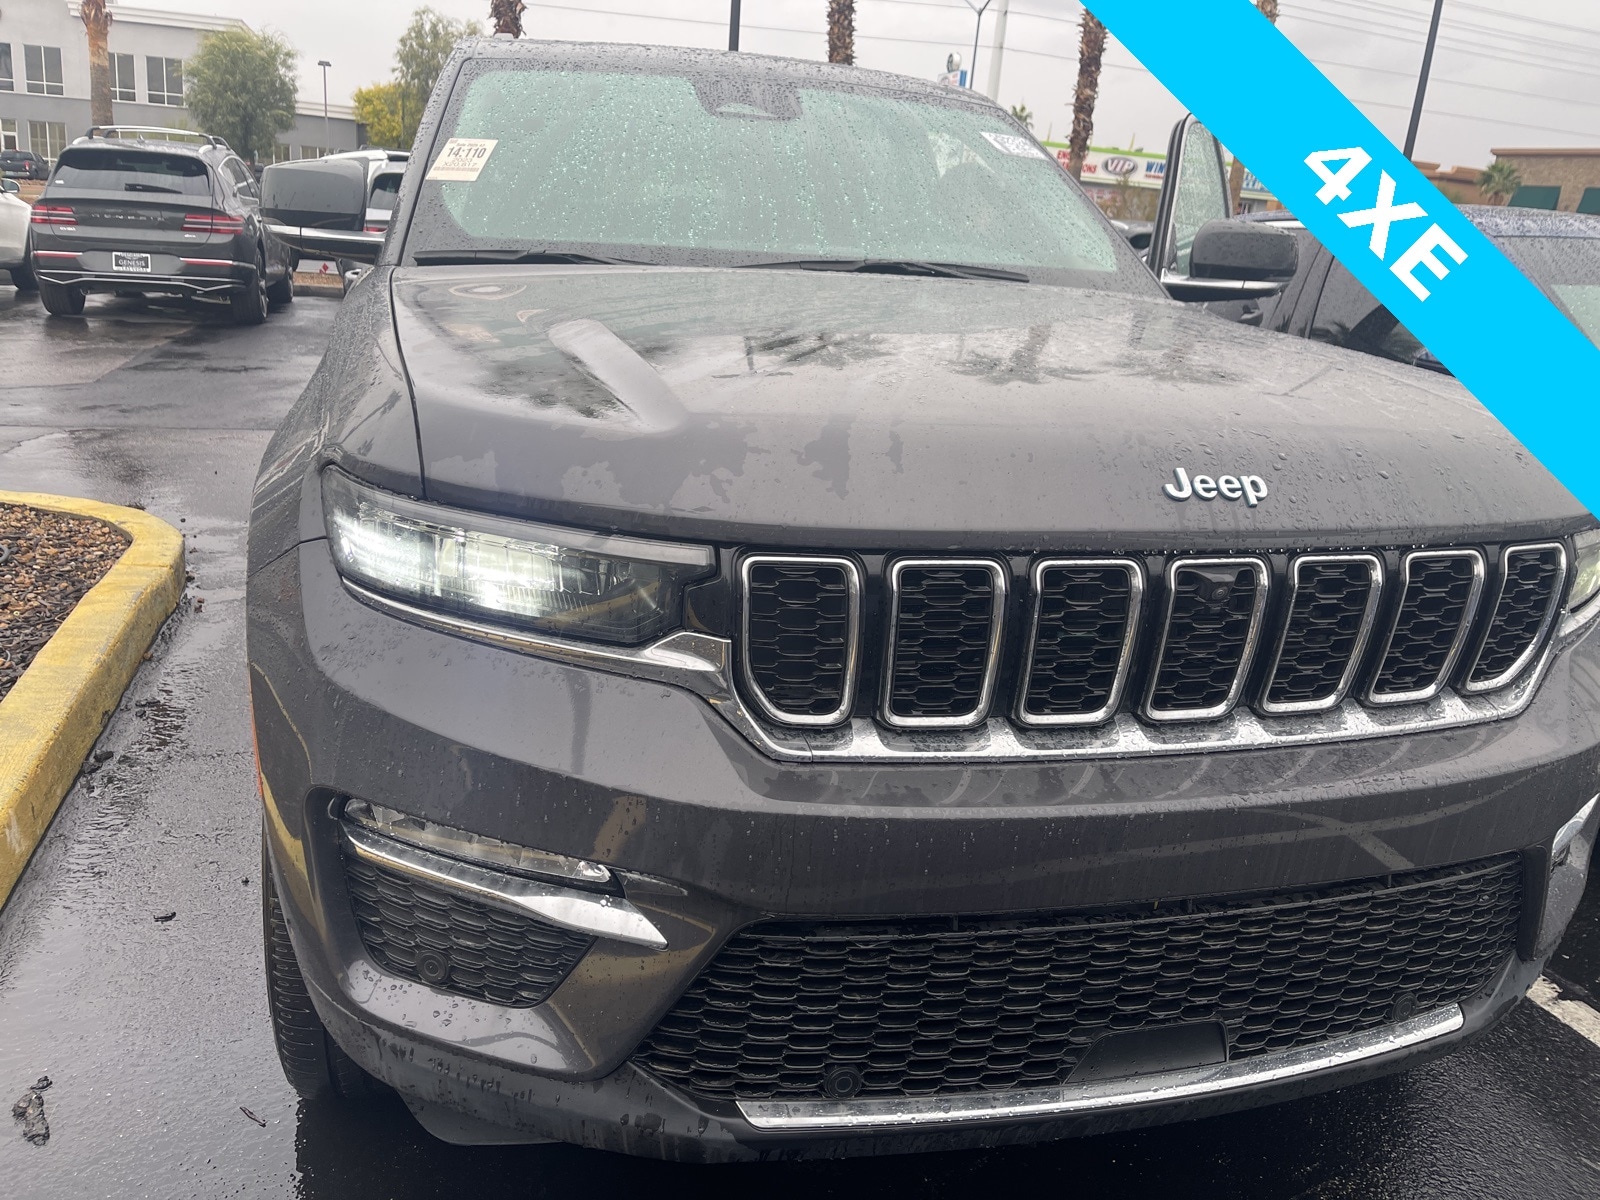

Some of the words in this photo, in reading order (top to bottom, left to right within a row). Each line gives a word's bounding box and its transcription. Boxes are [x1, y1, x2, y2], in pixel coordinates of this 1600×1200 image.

[1107, 158, 1134, 172] VIP
[118, 259, 146, 267] GENESIS
[1163, 467, 1268, 508] Jeep
